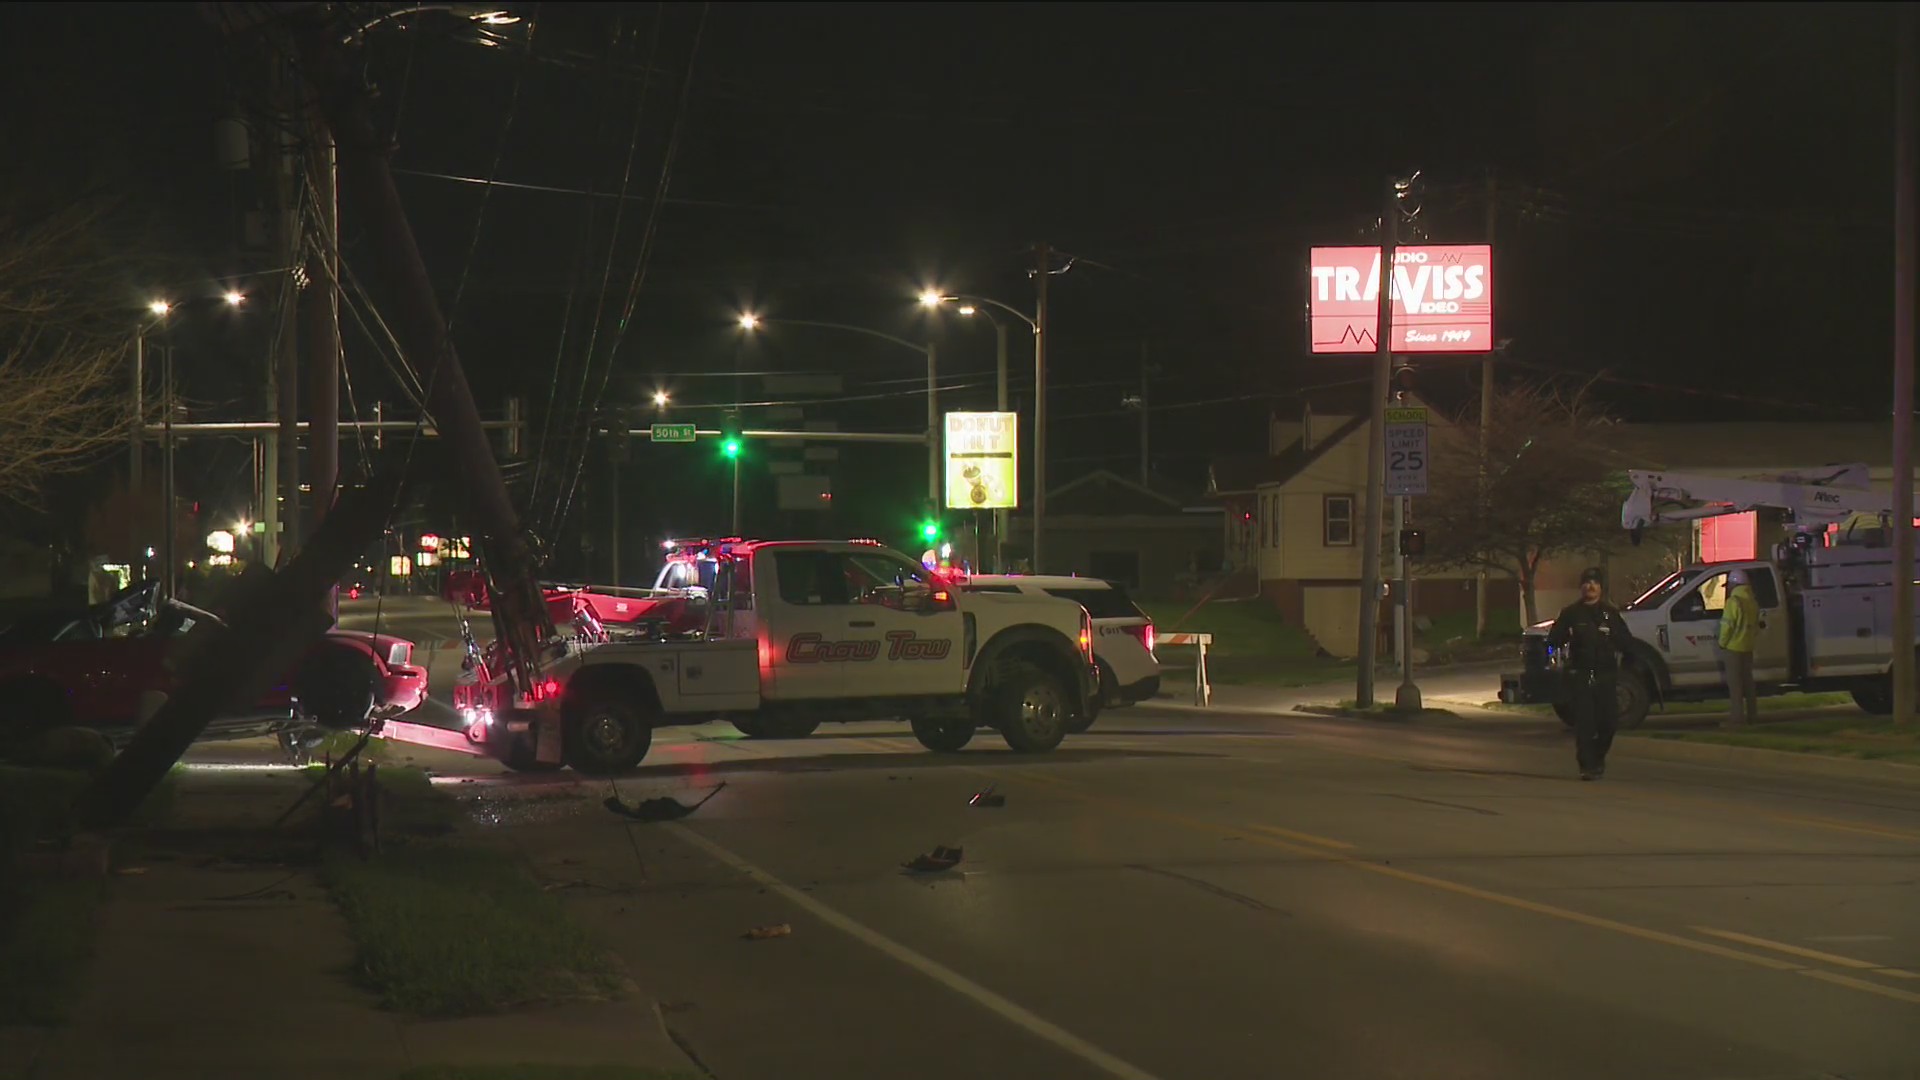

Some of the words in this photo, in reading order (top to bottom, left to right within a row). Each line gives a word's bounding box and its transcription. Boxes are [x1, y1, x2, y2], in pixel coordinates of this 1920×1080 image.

[1405, 329, 1437, 343] Since
[1387, 411, 1425, 420] SCHOOL
[949, 416, 1011, 432] DONUT
[656, 428, 679, 438] 50th
[1388, 428, 1425, 438] SPEED
[1391, 439, 1421, 449] LIMIT
[1390, 451, 1423, 470] 25
[885, 630, 951, 660] Tow
